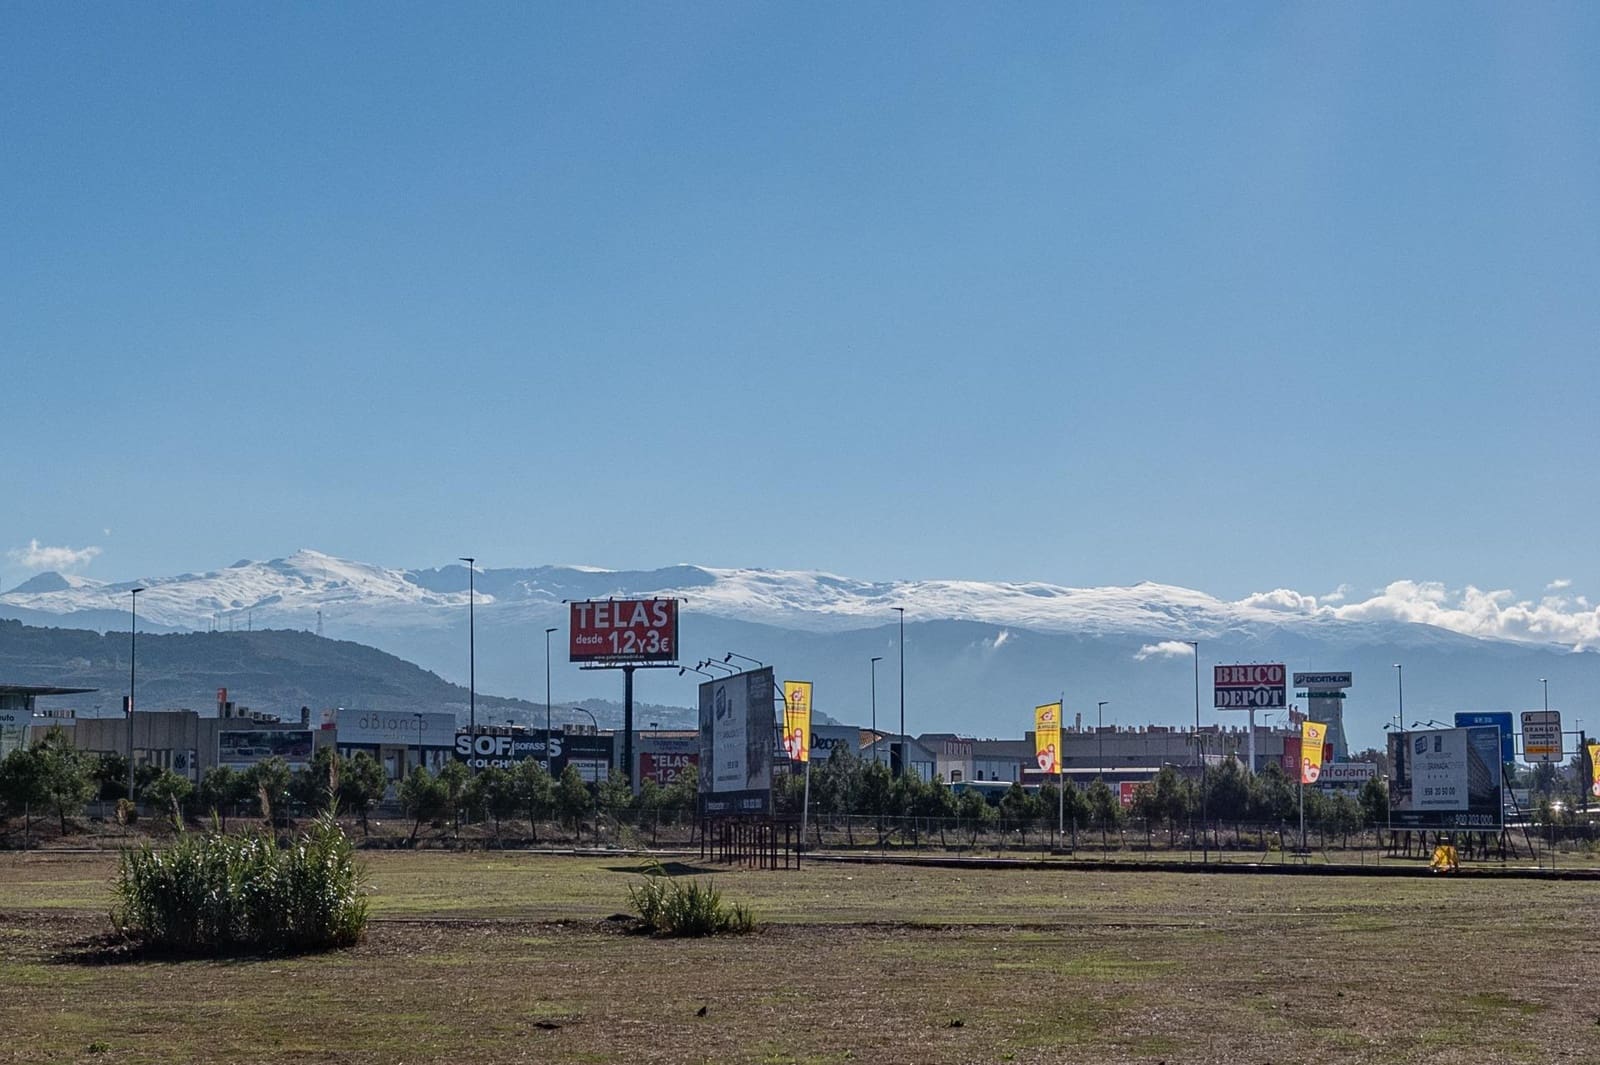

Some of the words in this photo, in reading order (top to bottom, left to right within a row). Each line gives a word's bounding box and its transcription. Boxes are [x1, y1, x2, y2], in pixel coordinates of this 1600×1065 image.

[576, 601, 668, 629] TELAS
[576, 634, 603, 645] desde
[1215, 666, 1283, 683] BRICO
[1306, 674, 1350, 683] DECATHLON
